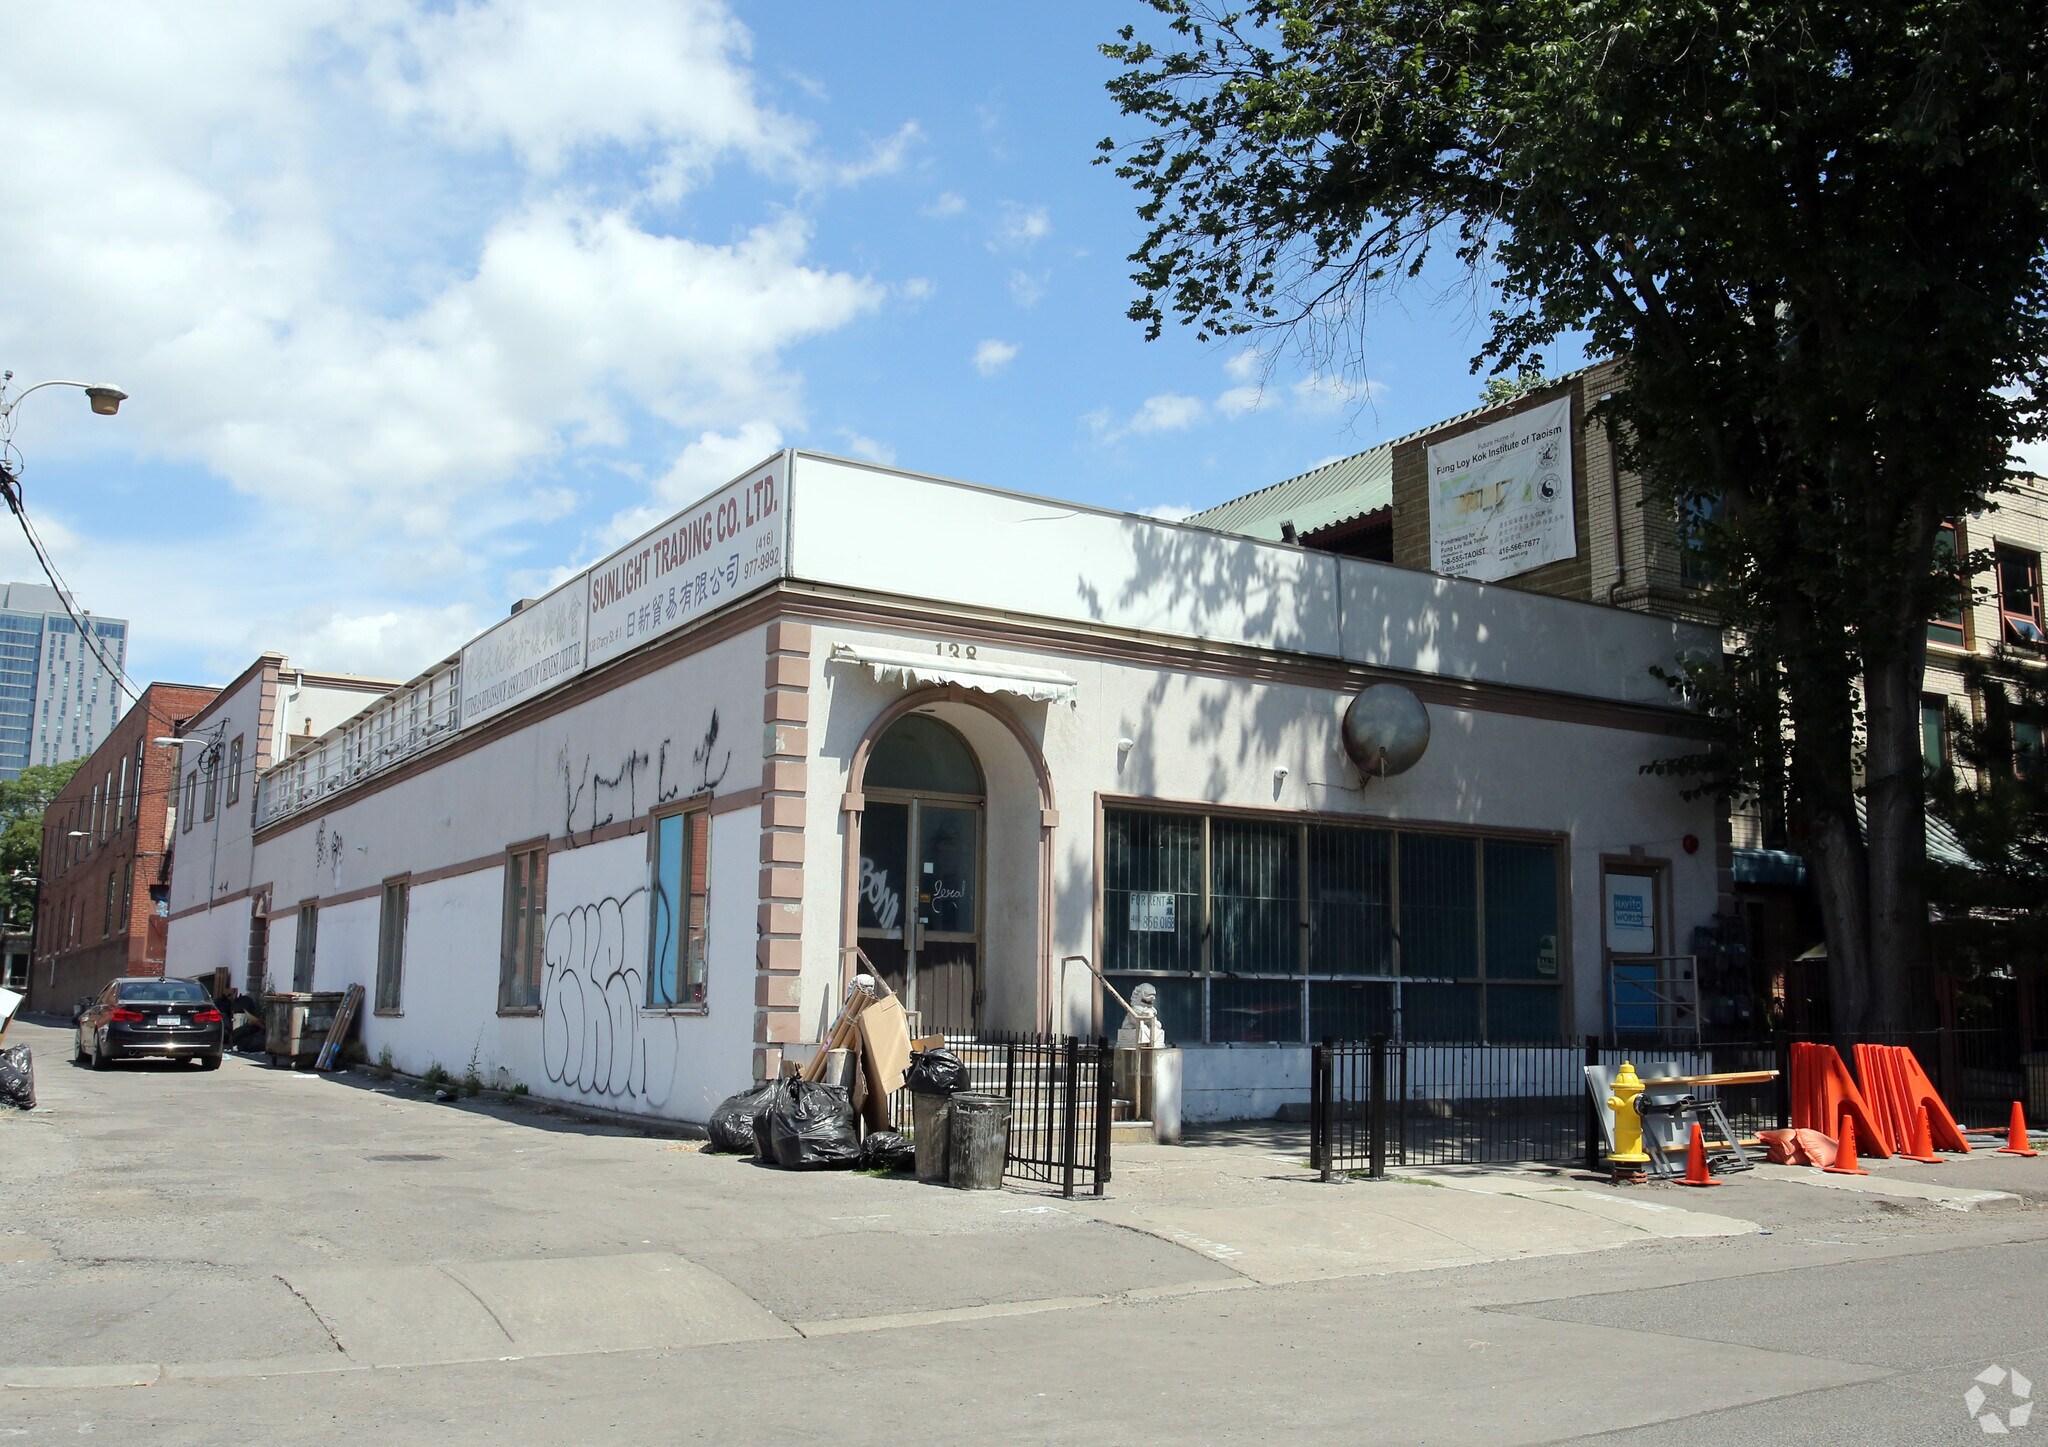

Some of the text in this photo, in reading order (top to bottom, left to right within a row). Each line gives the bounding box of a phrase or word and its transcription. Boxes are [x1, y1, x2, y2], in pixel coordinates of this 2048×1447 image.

[1437, 426, 1562, 475] Fung Loy Kok Institute of Taoism
[1478, 440, 1493, 450] Future
[1494, 436, 1509, 444] Home
[592, 474, 778, 613] SUNLIGHT TRADING CO. LTD.
[756, 530, 774, 554] (416)
[1499, 538, 1540, 555] 416-566-7877
[744, 546, 779, 580] 977-9992
[626, 553, 740, 639] 日新貿易有限公司
[936, 642, 977, 660] 138
[1131, 894, 1166, 906] FOR RENT
[1616, 912, 1641, 922] WORLD
